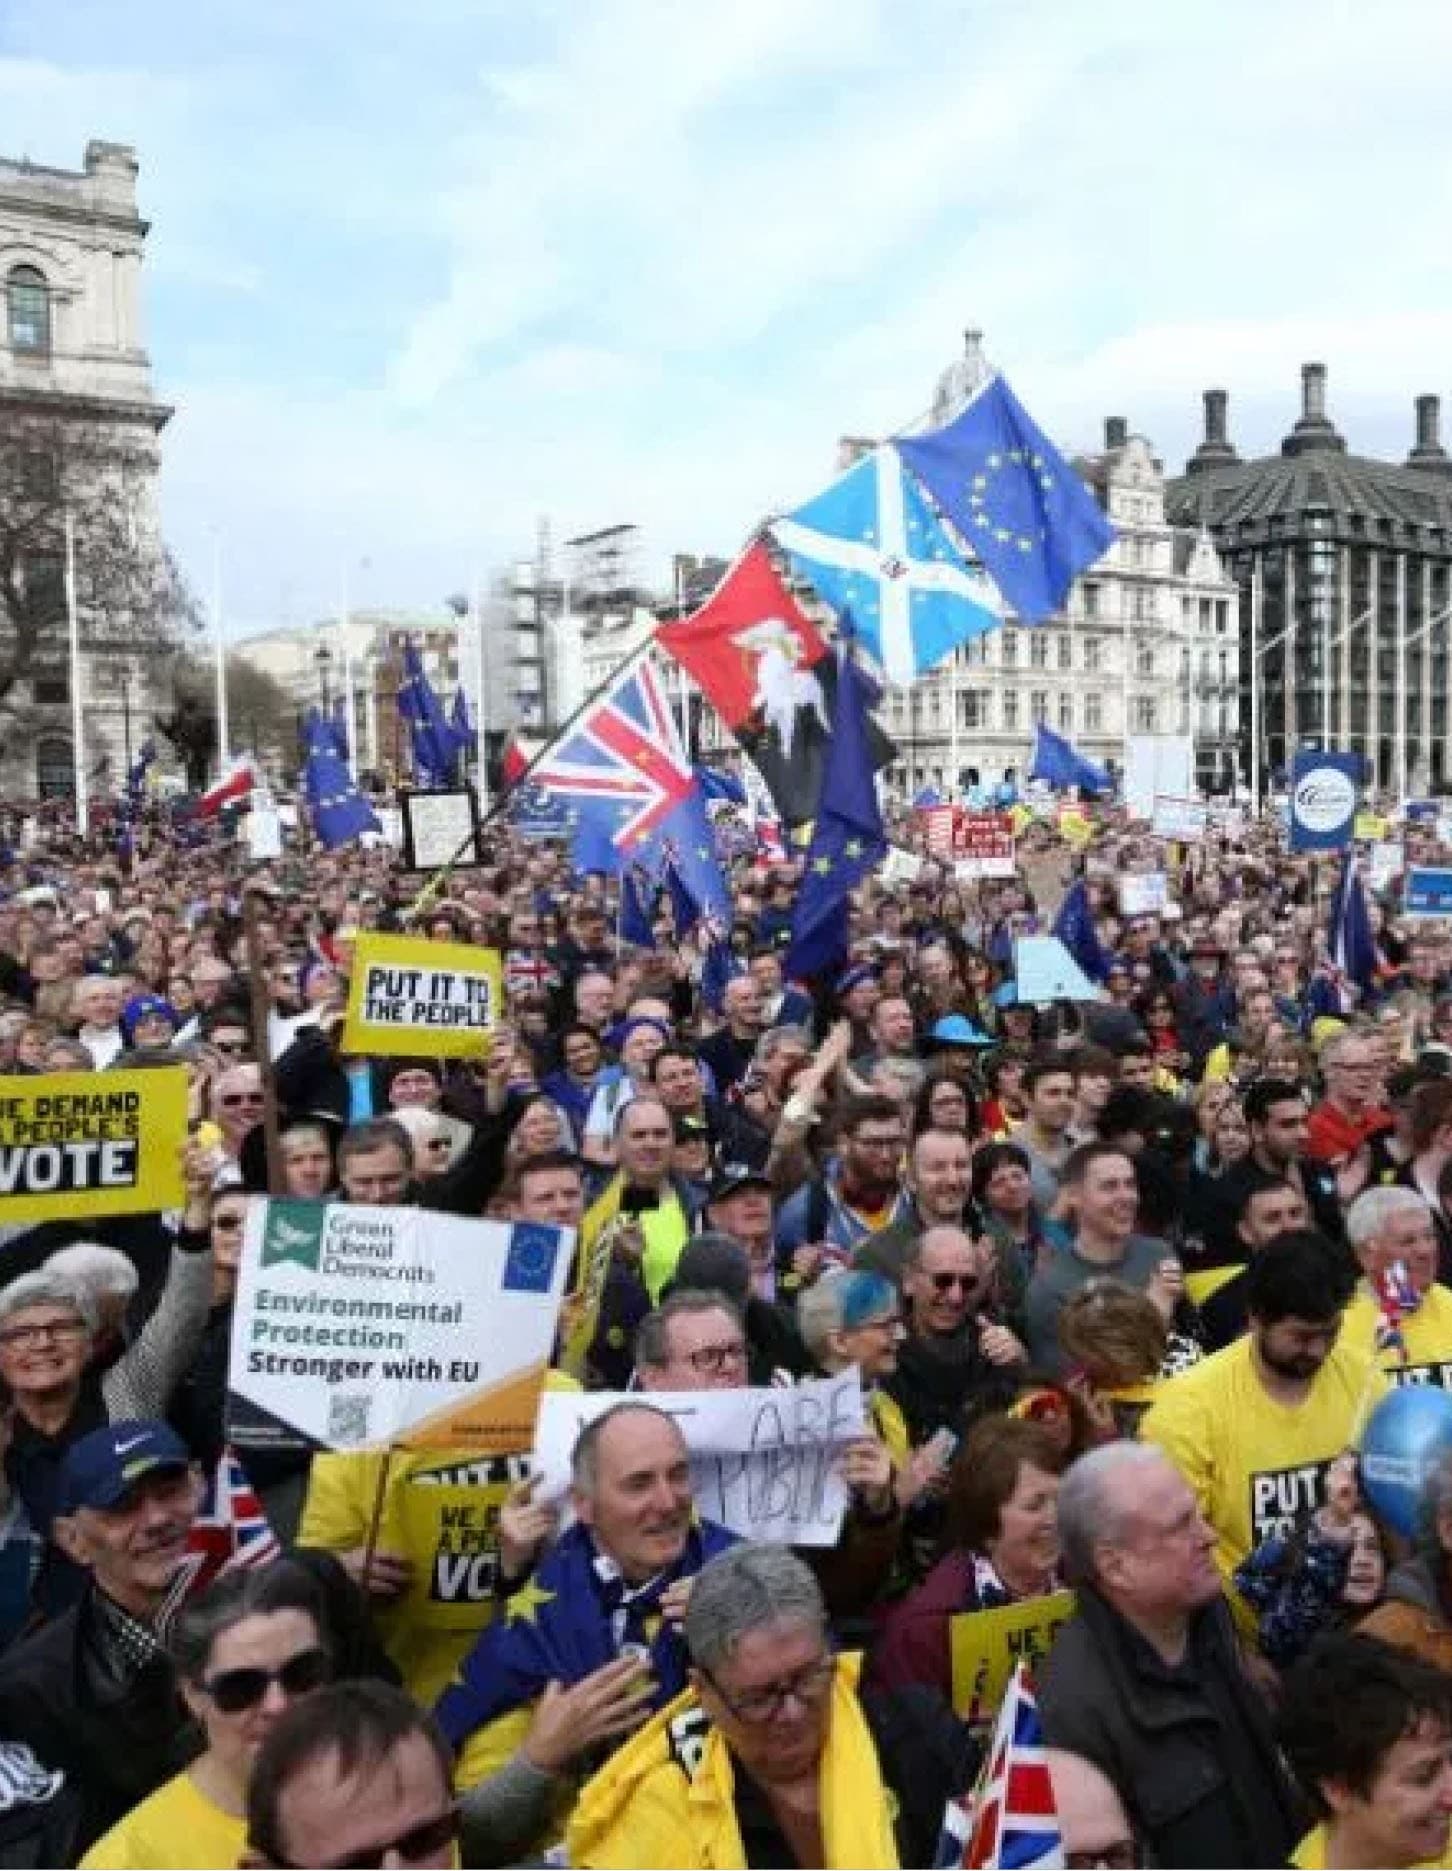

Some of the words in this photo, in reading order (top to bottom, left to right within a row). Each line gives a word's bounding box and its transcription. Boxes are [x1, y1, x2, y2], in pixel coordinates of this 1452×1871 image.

[368, 967, 422, 998] PUT
[431, 972, 456, 1001] IT
[463, 975, 489, 1005] TO
[366, 998, 406, 1021] THE
[411, 1002, 490, 1027] PEOPLE
[36, 1090, 141, 1117] DEMAND
[13, 1114, 141, 1143] PEOPLE'S
[0, 1140, 137, 1192] VOTE
[328, 1213, 394, 1237] Green
[324, 1235, 395, 1259] Liberal
[322, 1256, 436, 1285] Democrats
[256, 1288, 463, 1324] Environmental
[252, 1319, 408, 1351] Protection
[248, 1350, 374, 1386] Stronger
[381, 1357, 443, 1381] with
[450, 1360, 480, 1383] EU
[752, 1381, 852, 1449] ARE
[1254, 1468, 1319, 1515] PUT
[436, 1551, 498, 1599] VO
[1006, 1627, 1044, 1654] WE
